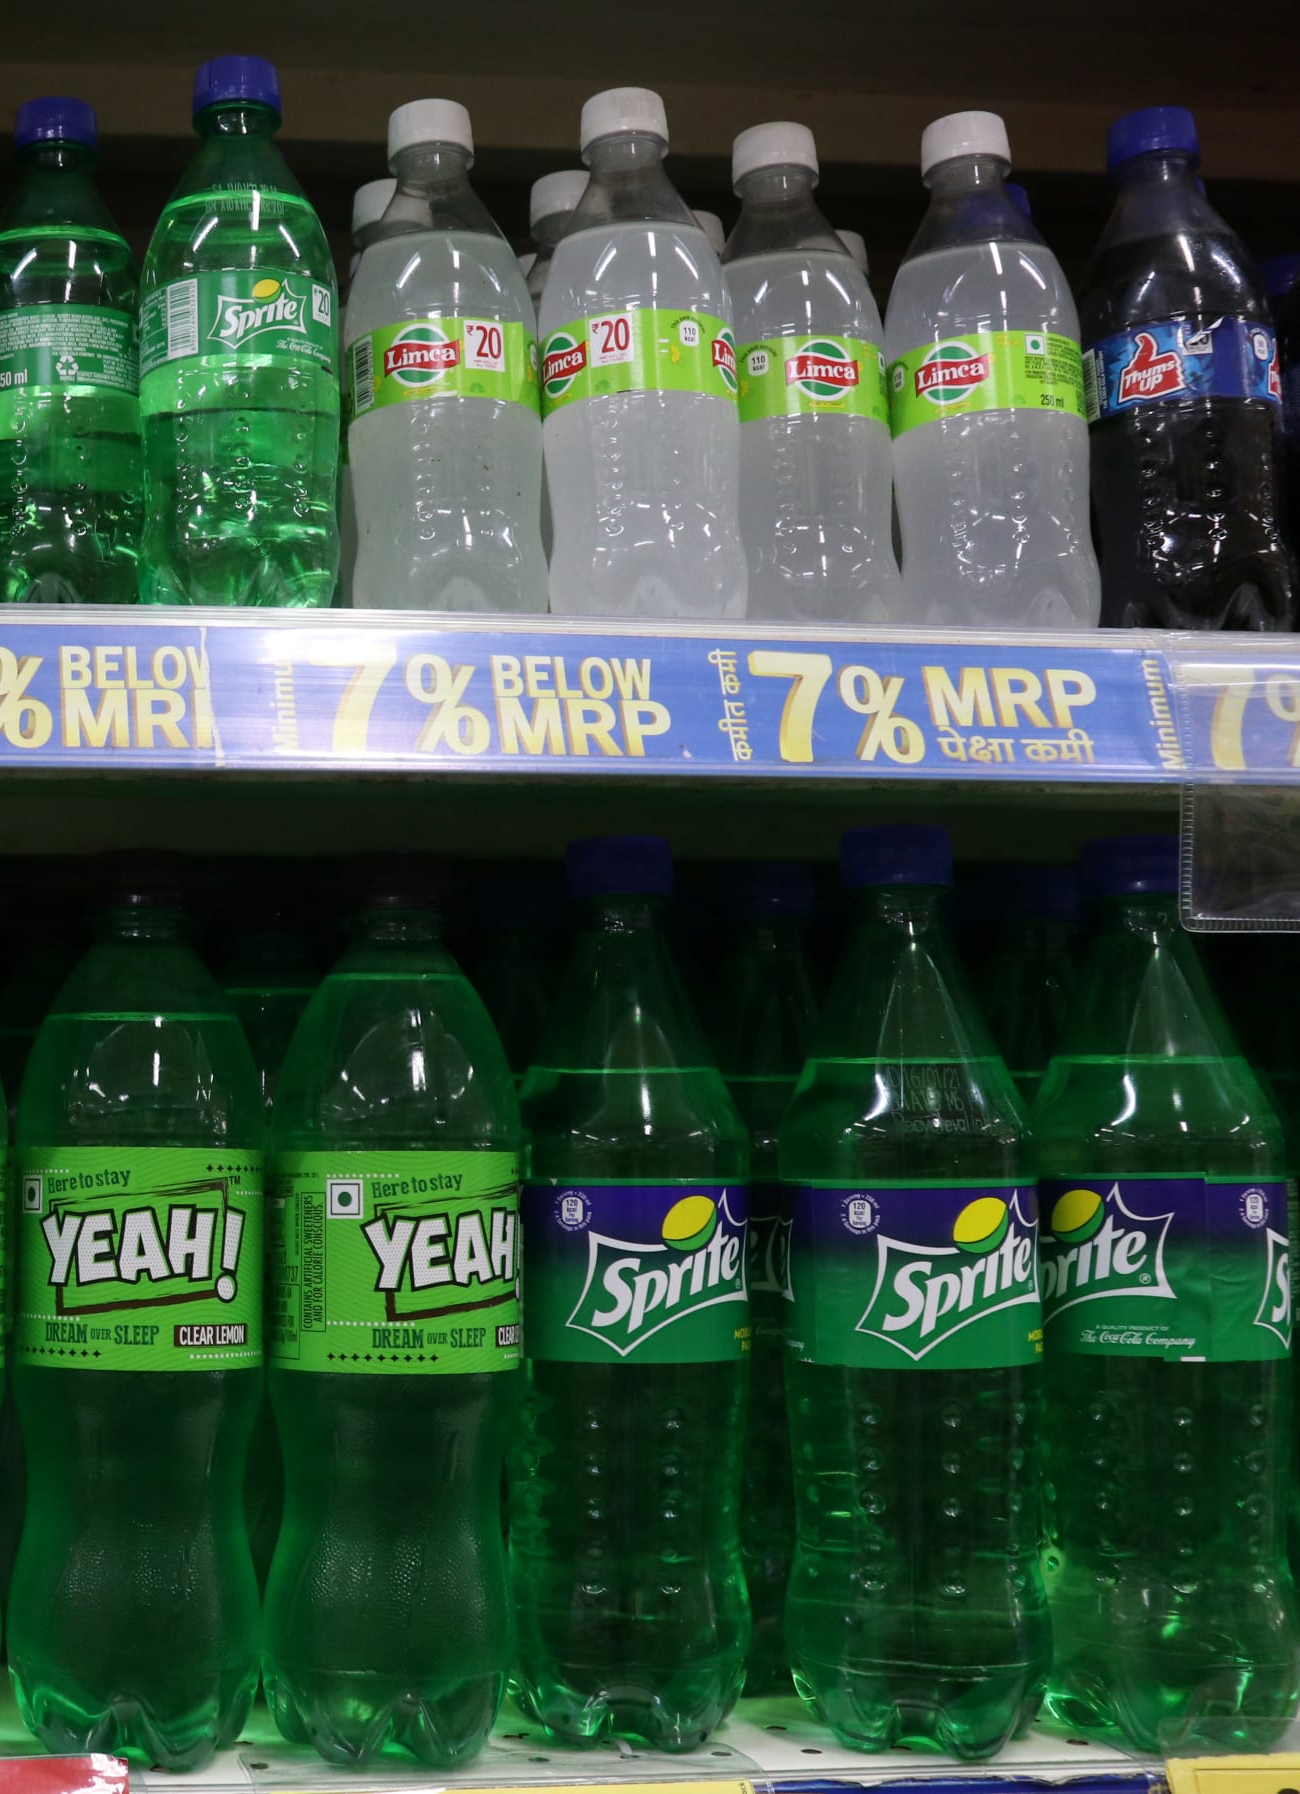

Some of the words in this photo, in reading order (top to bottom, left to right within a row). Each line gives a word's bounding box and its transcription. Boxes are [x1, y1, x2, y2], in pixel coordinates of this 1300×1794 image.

[219, 292, 298, 340] Sprite
[683, 327, 697, 336] 110
[466, 325, 503, 360] ₹20
[591, 317, 631, 354] ₹20
[386, 346, 456, 369] Limca
[543, 350, 583, 383] Limca
[751, 356, 766, 364] 110
[790, 360, 857, 380] Limca
[1124, 359, 1175, 388] Thums
[14, 368, 28, 385] ml
[917, 361, 985, 389] Limca
[1140, 373, 1163, 391] UP
[1040, 394, 1054, 407] 250
[1055, 396, 1065, 408] ml
[491, 655, 652, 700] BELOW
[270, 656, 296, 754] Minimu
[920, 666, 1097, 729] MRP
[496, 698, 671, 757] MRP
[1140, 657, 1187, 772] Minimum
[935, 725, 1016, 764] पेक्षा
[1020, 727, 1094, 764] कमी
[47, 1174, 77, 1194] Here
[79, 1173, 93, 1189] to
[96, 1169, 131, 1187] stay
[371, 1180, 409, 1199] Here
[411, 1177, 428, 1193] to
[429, 1173, 463, 1192] stay
[303, 1195, 313, 1244] SWEETENERS
[853, 1202, 866, 1210] 120
[313, 1202, 323, 1249] CONSCIOUS.
[40, 1204, 246, 1304] YEAH!
[360, 1207, 516, 1292] YEAH
[303, 1247, 313, 1288] ARTIFICIAL
[313, 1253, 323, 1285] CALORIE
[591, 1220, 741, 1334] Sprite
[881, 1221, 1032, 1338] Sprite
[303, 1290, 313, 1329] CONTAINS
[313, 1287, 323, 1302] FOR
[313, 1304, 323, 1323] AND
[45, 1322, 88, 1344] DREAM
[90, 1328, 112, 1340] OVER
[114, 1325, 159, 1345] SLEEP
[179, 1326, 213, 1346] CLEAR
[215, 1325, 245, 1345] LEMON
[372, 1328, 424, 1349] DREAM
[427, 1333, 448, 1345] OVER
[450, 1328, 486, 1348] SLEEP
[1080, 1331, 1097, 1343] The
[1099, 1331, 1142, 1343] Coca-Cola
[1145, 1332, 1196, 1349] Company
